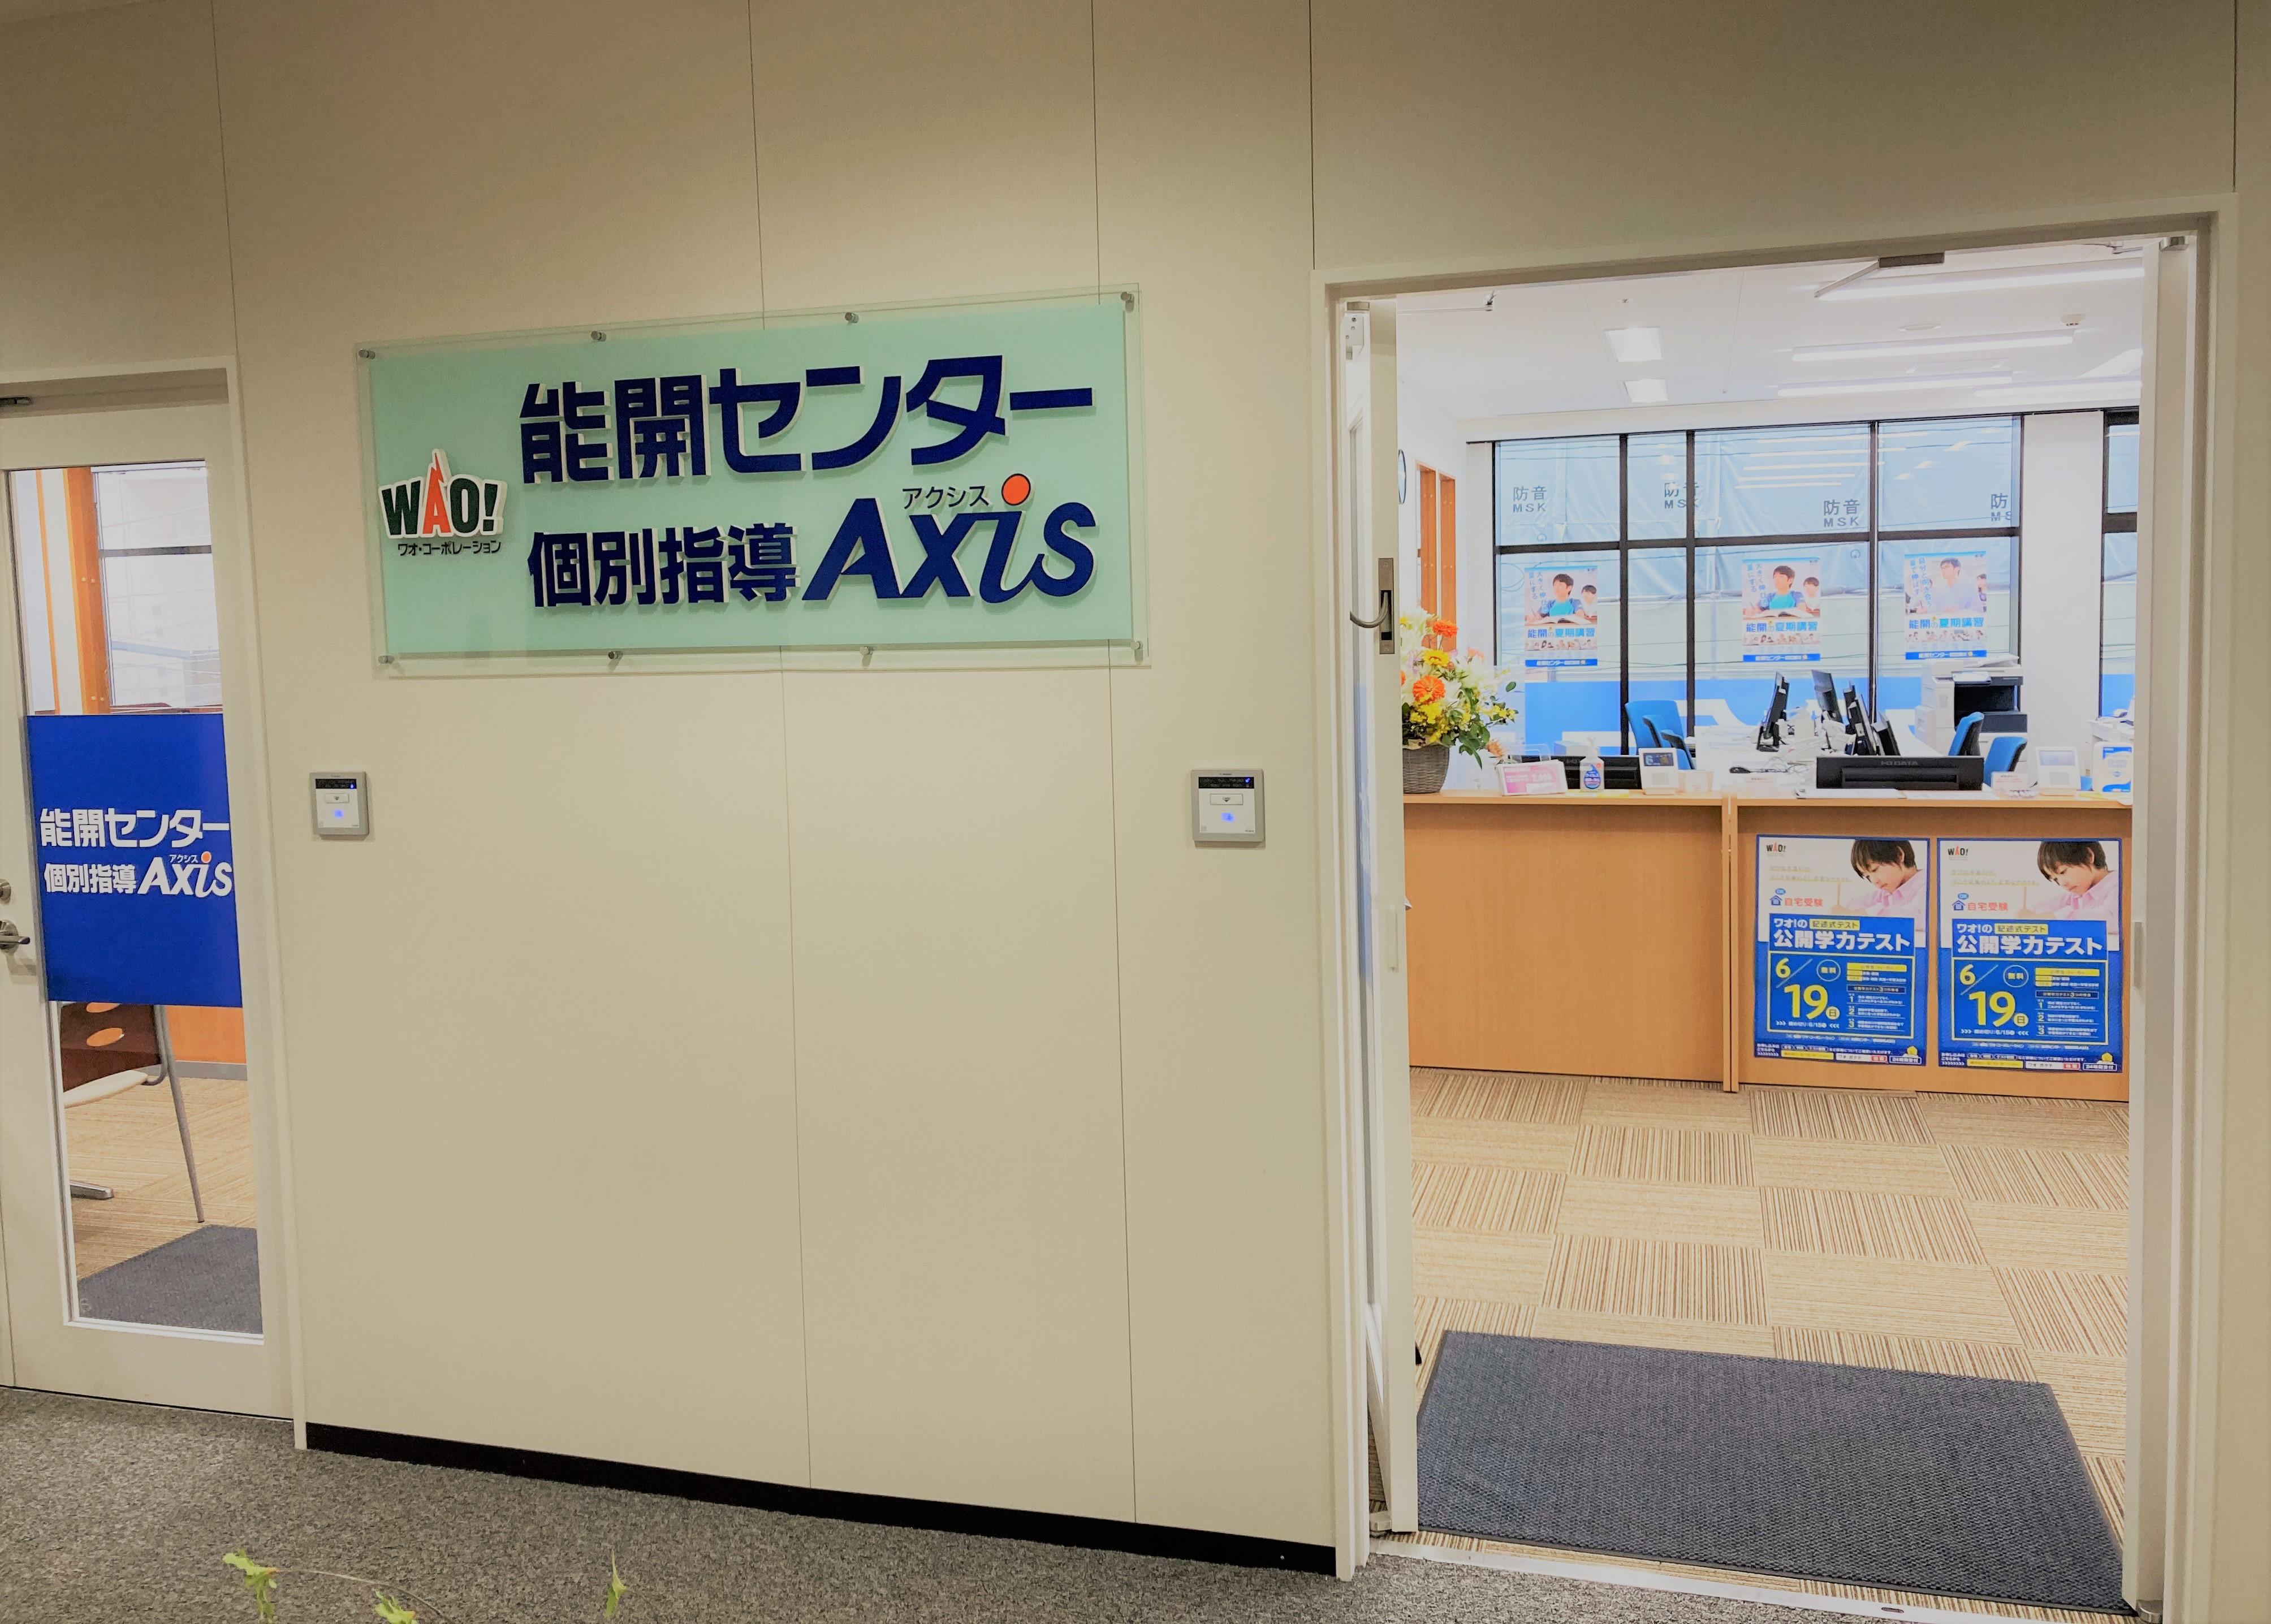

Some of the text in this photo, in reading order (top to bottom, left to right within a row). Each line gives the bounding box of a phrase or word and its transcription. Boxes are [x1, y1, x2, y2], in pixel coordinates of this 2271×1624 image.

[519, 355, 1094, 484] 能開センター
[381, 452, 499, 535] WAO!
[902, 485, 990, 509] アクシス
[1513, 485, 1547, 502] 防音
[1991, 493, 2009, 509] 防
[1513, 502, 1546, 513] MSK
[1823, 499, 1860, 516] 防音
[1823, 517, 1859, 528] MSK
[398, 539, 501, 556] ワオ・コーポレーション
[526, 473, 1096, 607] 個別指導 Axis
[1746, 621, 1818, 633] 能開の夏期講習
[1909, 617, 1984, 629] 能開の夏期講習
[1527, 628, 1595, 638] 能開の夏期講習
[40, 808, 230, 848] 能開センター
[1766, 842, 1786, 852] WAO!
[1948, 845, 1968, 856] WAO!
[169, 854, 198, 863] アクシス
[44, 851, 232, 898] 個別指導 Axis
[1784, 897, 1823, 907] 自宅受験
[1967, 902, 2009, 911] 自宅受験
[1773, 930, 1911, 951] 公開学力テスト
[1956, 935, 2103, 955] 公開学力テスト
